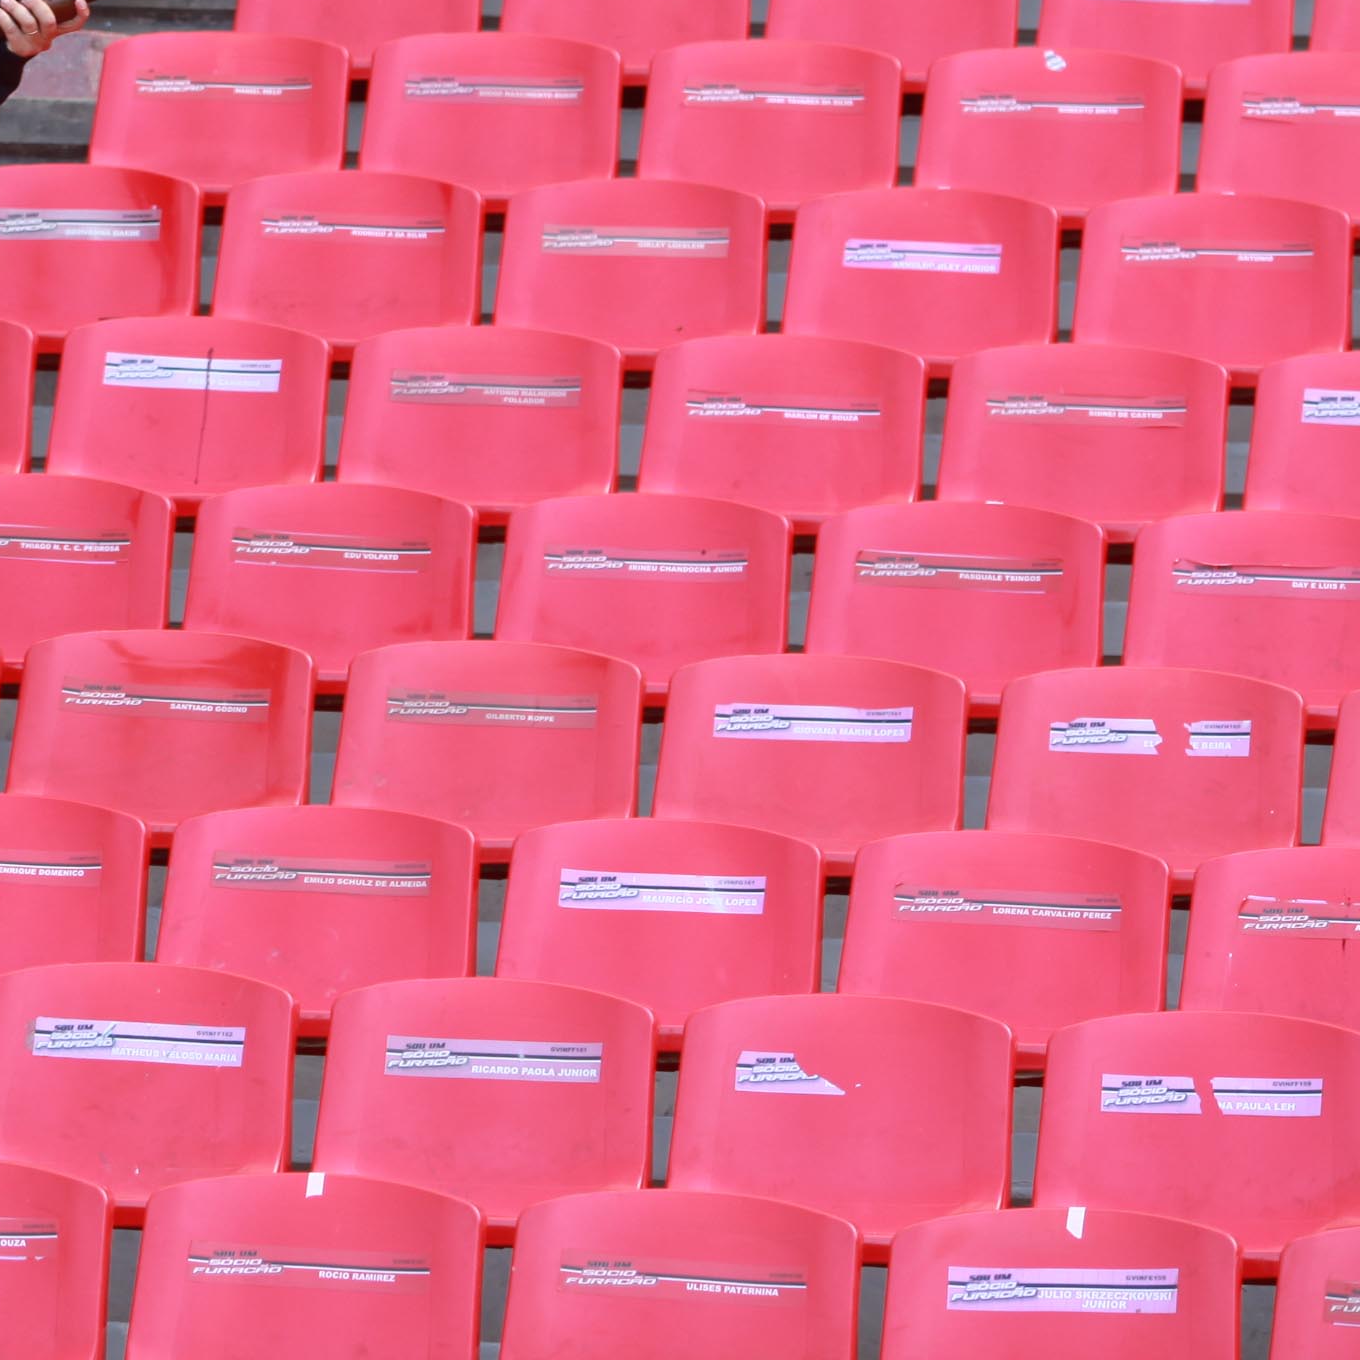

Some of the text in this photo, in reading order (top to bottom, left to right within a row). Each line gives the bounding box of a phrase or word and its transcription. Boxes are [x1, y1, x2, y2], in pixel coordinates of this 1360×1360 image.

[303, 876, 335, 886] EMILIO
[337, 878, 373, 887] SCHULZ
[388, 879, 428, 889] ALMEIDA
[992, 906, 1112, 920] LORENA CARVALHO PEREZ
[111, 1047, 160, 1058] MATHEUS
[203, 1052, 237, 1062] MARIA
[470, 1064, 598, 1079] RICARDO PAOLA JUNIOR
[1235, 1101, 1296, 1112] PAULA LEH
[192, 1263, 284, 1275] FURACÃO
[318, 1270, 396, 1283] ROCIO RAMIREZ
[565, 1275, 658, 1286] FURACÃO
[968, 1274, 991, 1282] SOU
[685, 1282, 779, 1297] ULISES PATERNINA
[950, 1287, 1038, 1302] FURACÃO
[1036, 1290, 1173, 1302] JULIO SKRZECZKOVSKI
[1081, 1299, 1127, 1310] JUNIOR
